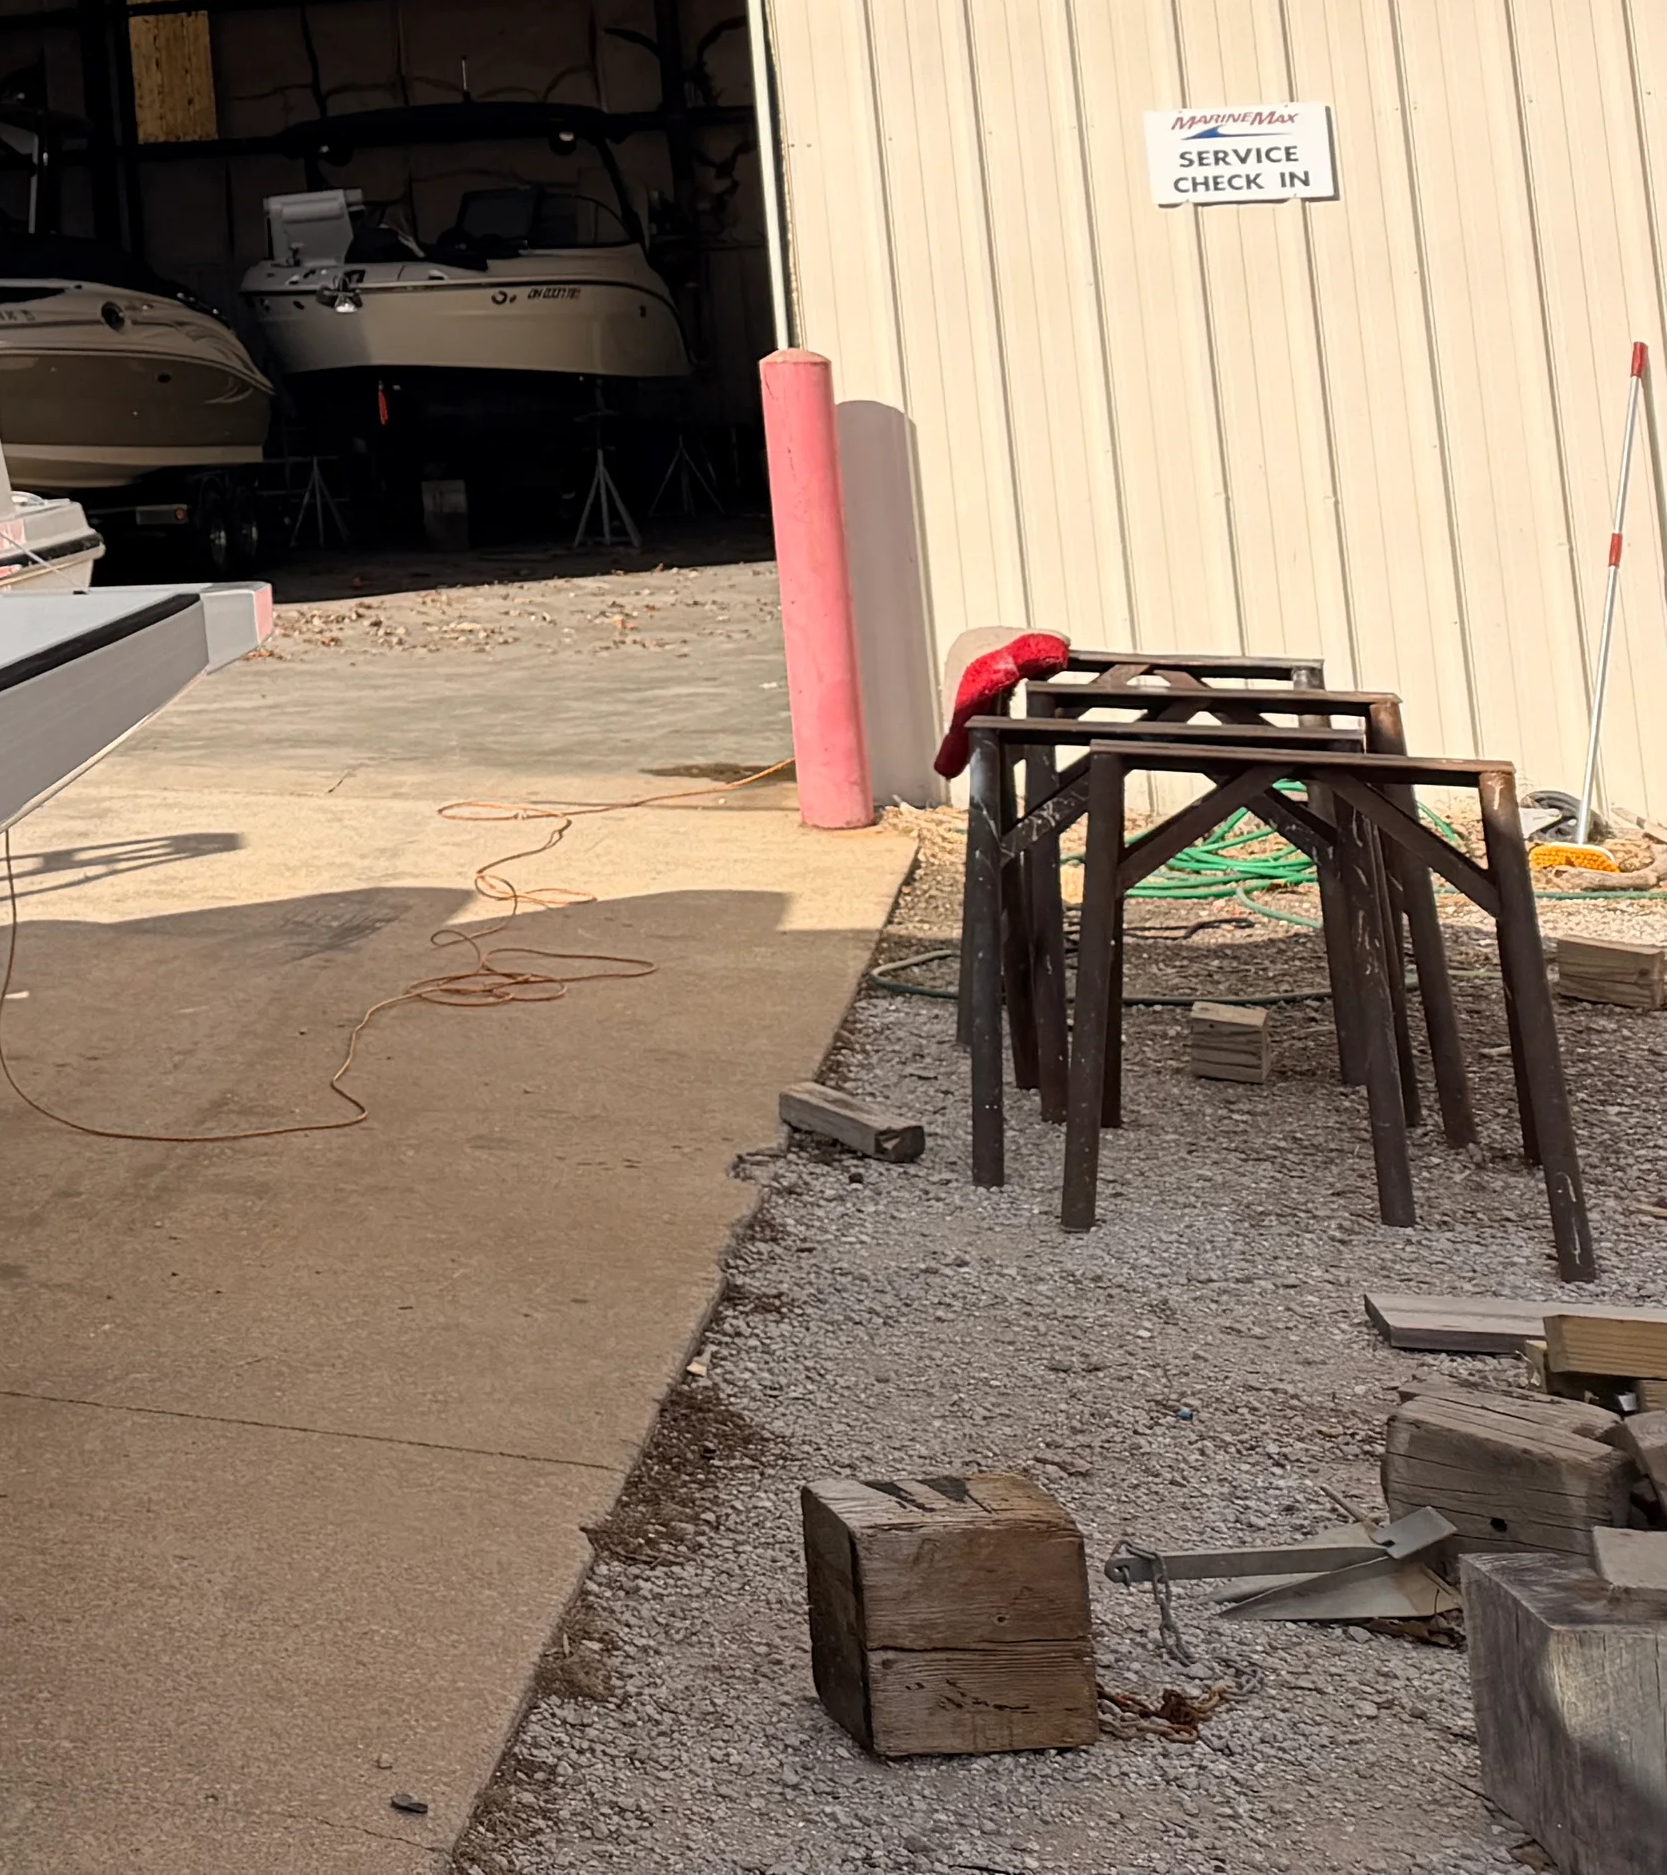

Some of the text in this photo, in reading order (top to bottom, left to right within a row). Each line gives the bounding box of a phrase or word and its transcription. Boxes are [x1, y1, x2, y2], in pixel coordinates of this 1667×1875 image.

[1179, 145, 1299, 168] SERVICE
[1173, 170, 1310, 193] CHECK IN
